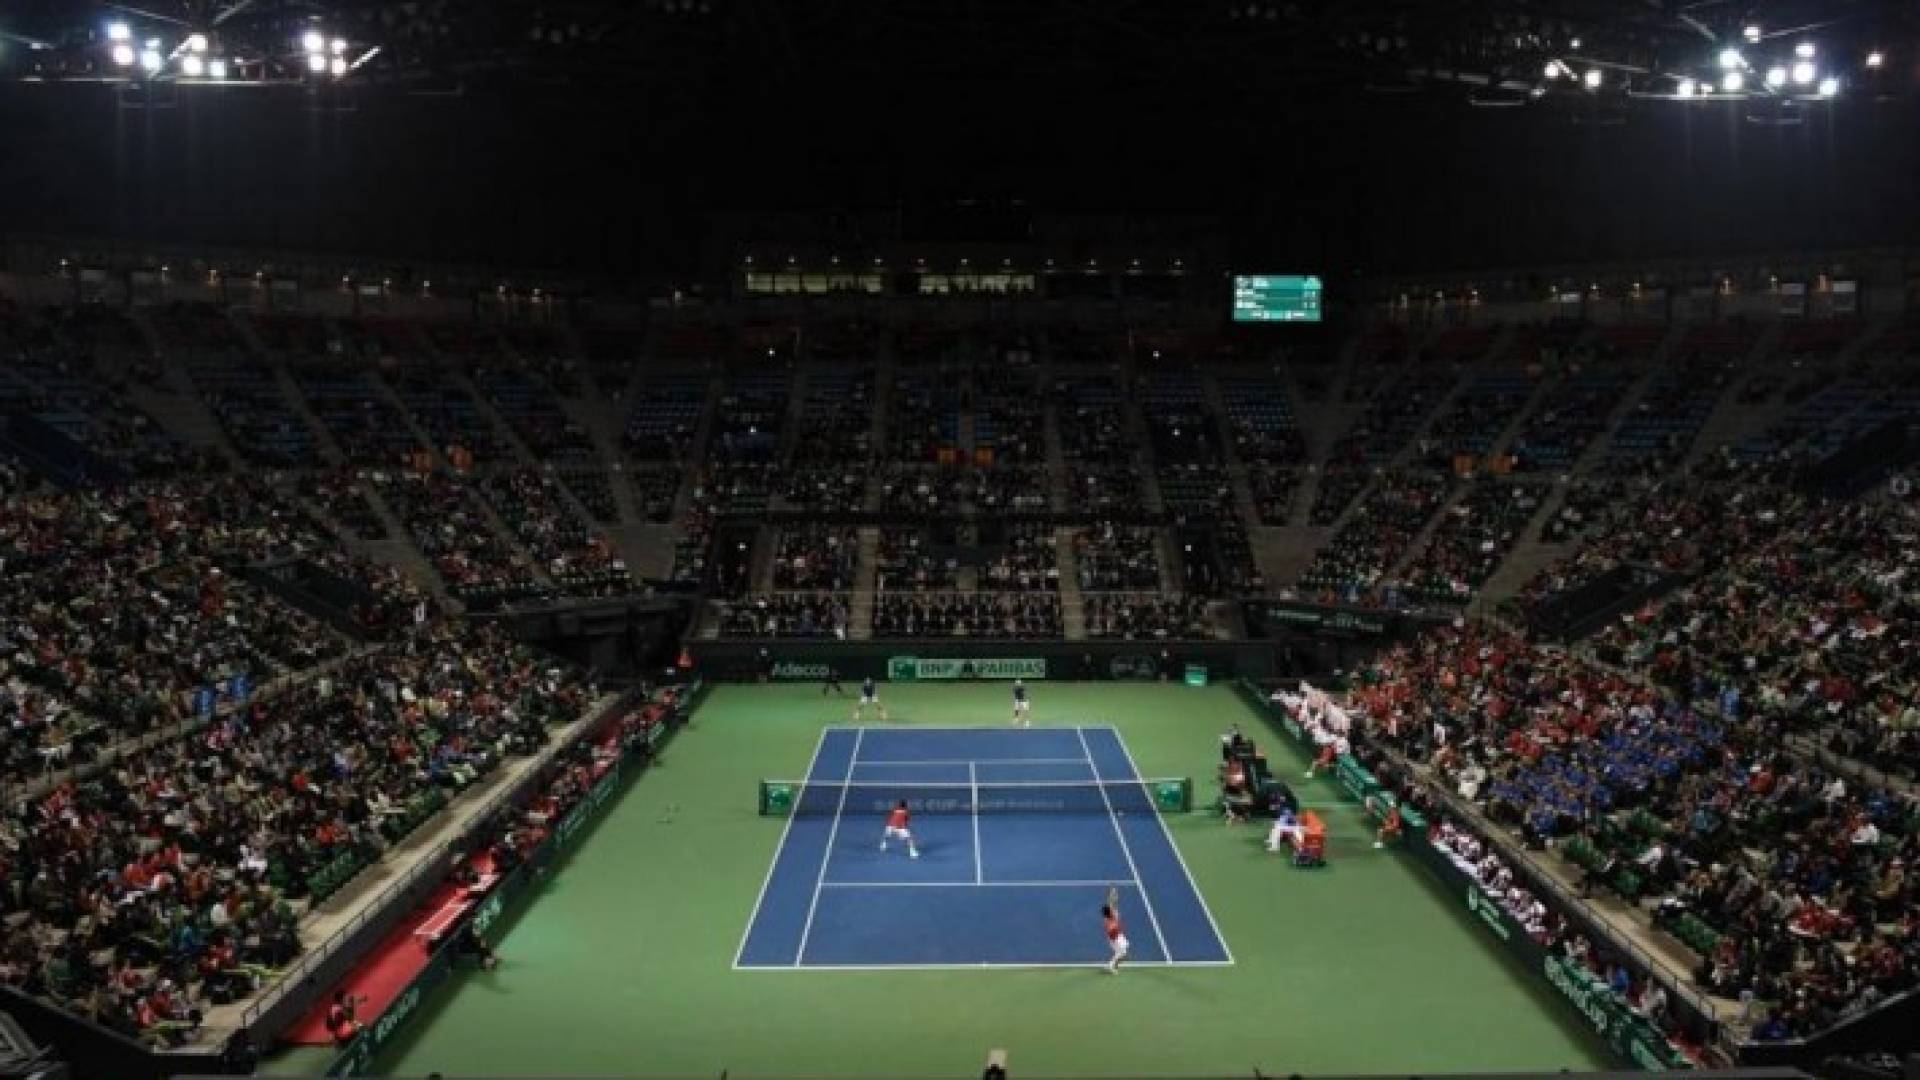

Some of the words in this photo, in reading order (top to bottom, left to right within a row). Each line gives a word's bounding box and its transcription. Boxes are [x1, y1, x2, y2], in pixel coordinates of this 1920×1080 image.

[772, 662, 829, 676] Adecco
[920, 662, 955, 674] BNP
[979, 662, 1045, 674] PARIBAS
